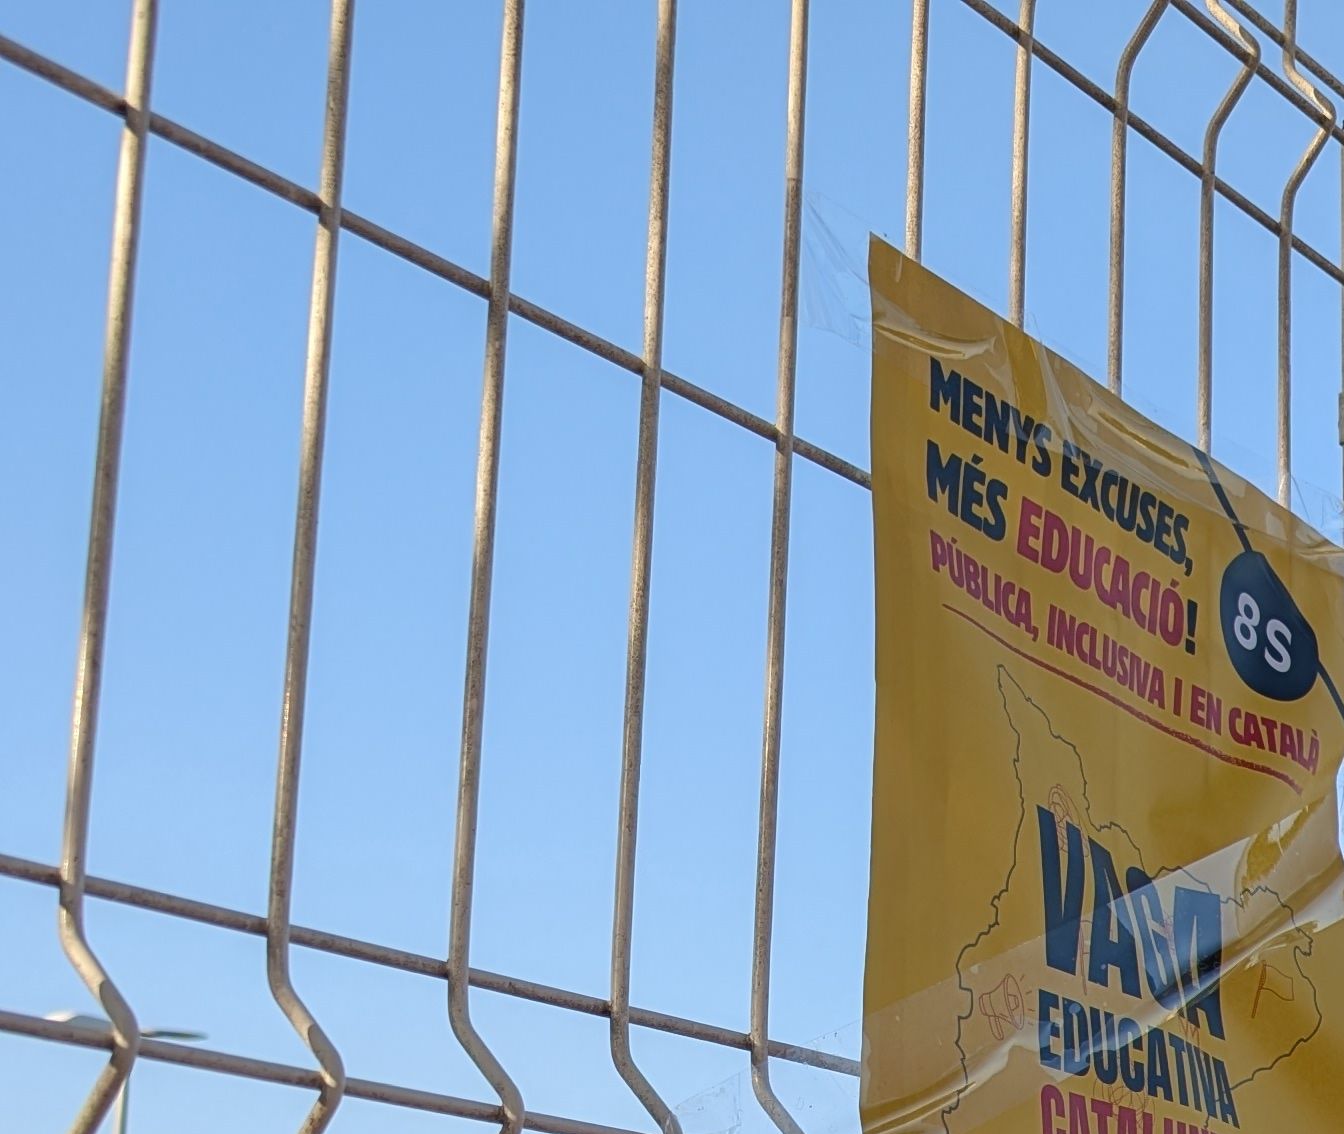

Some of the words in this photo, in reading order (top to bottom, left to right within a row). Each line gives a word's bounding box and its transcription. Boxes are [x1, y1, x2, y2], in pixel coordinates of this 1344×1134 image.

[926, 440, 1008, 542] MÉS
[1016, 496, 1198, 655] EDUCACIÓ!
[930, 357, 1051, 478] MENYS
[1061, 445, 1194, 576] EXCUSES,
[930, 529, 1039, 643] PÚBLICA,
[1047, 605, 1165, 709] INCLUSIVA
[1173, 677, 1183, 717] I
[1190, 684, 1222, 736] EN
[1228, 707, 1320, 775] CATALÀ
[1036, 804, 1226, 1041] VAGA
[1038, 988, 1240, 1129] EDUCATIVA
